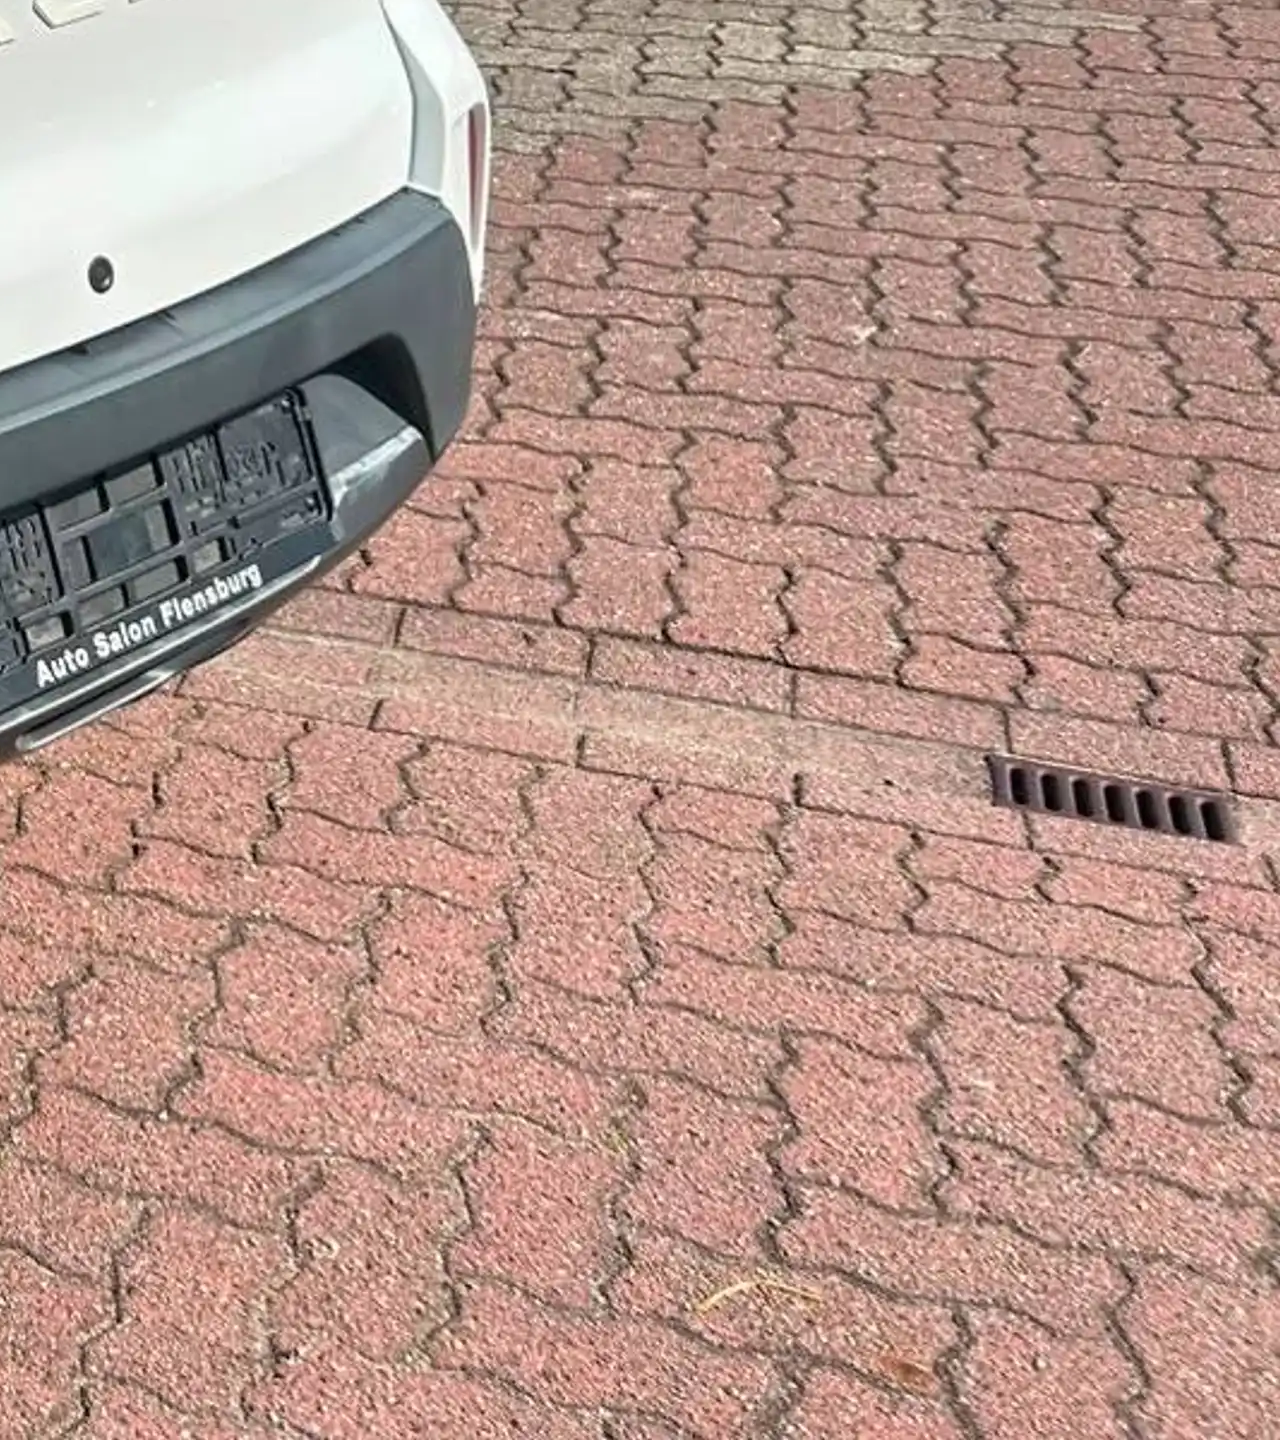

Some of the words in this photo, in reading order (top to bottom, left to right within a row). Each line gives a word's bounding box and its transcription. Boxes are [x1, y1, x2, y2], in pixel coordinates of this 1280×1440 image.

[36, 646, 89, 688] Auto
[92, 617, 156, 659] Salon
[158, 563, 263, 627] Flensburg
